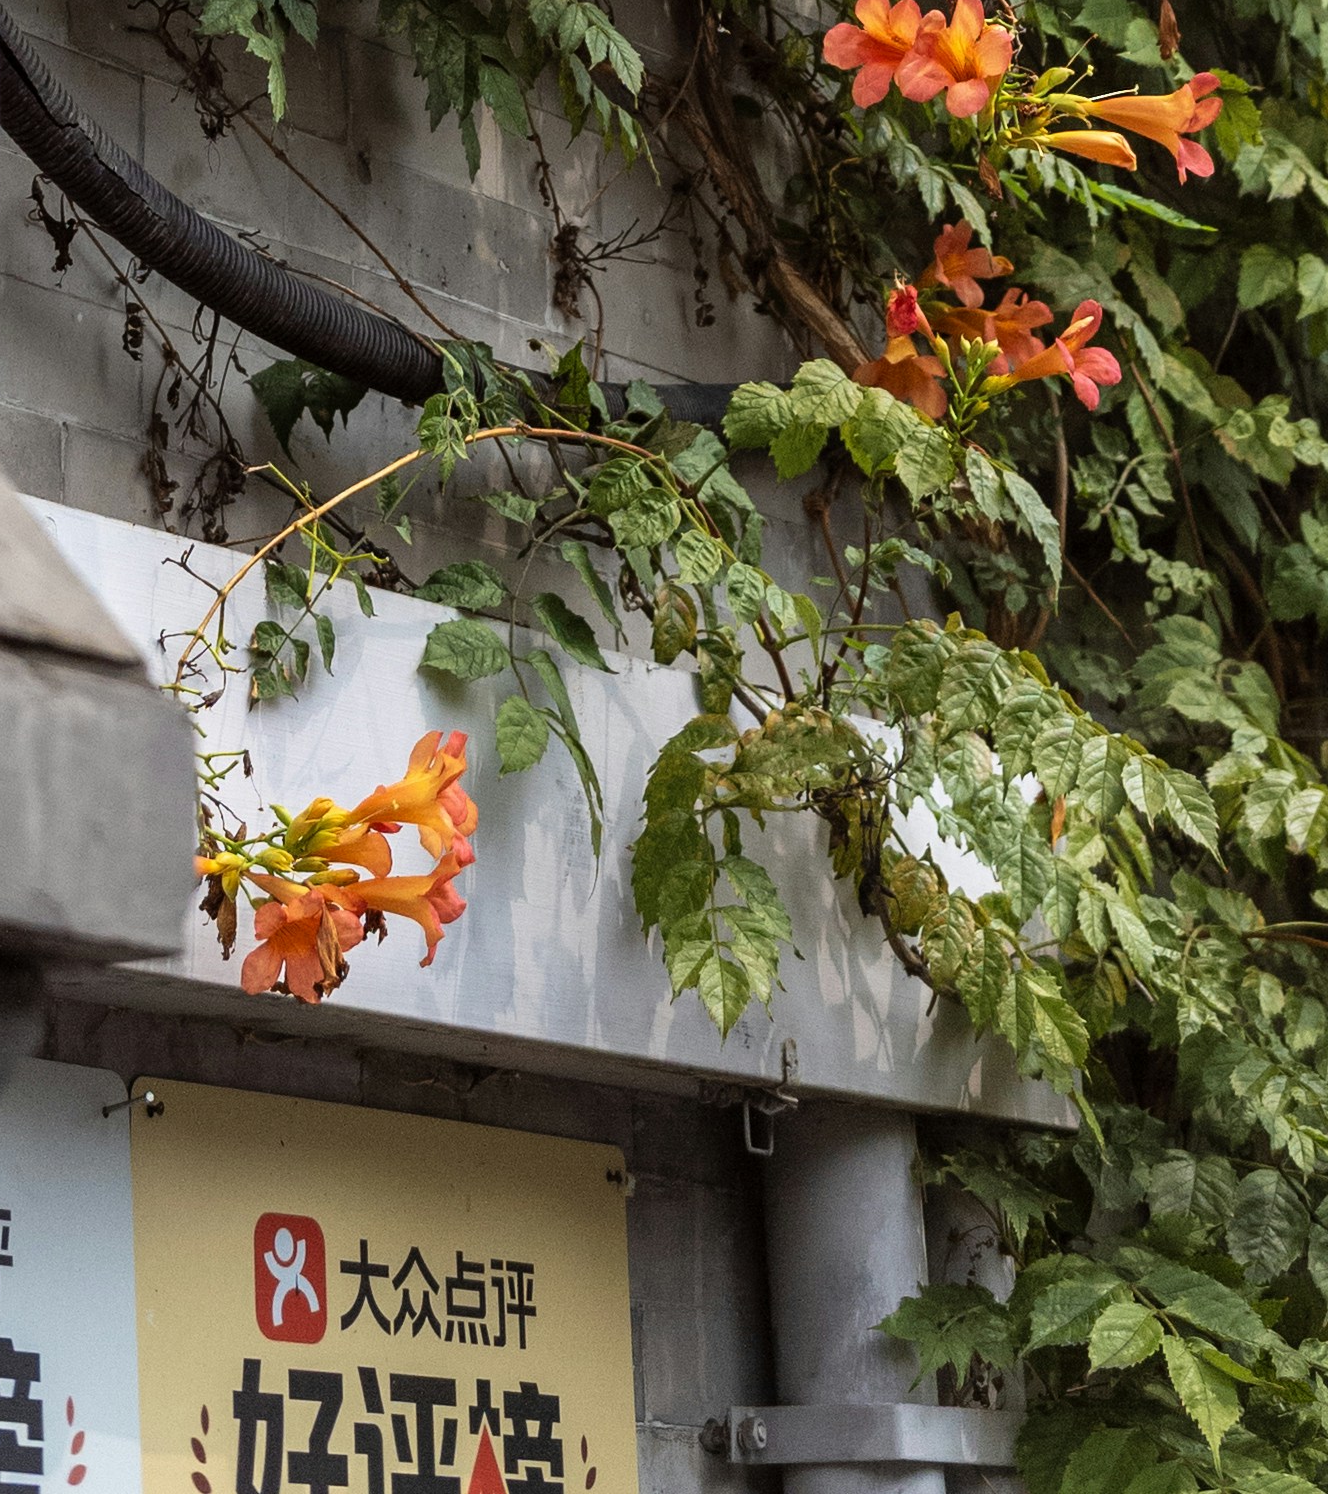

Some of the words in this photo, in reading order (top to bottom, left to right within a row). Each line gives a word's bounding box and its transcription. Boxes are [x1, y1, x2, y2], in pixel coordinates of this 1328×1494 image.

[339, 1238, 538, 1350] 大众点评
[232, 1357, 565, 1494] 好评榜
